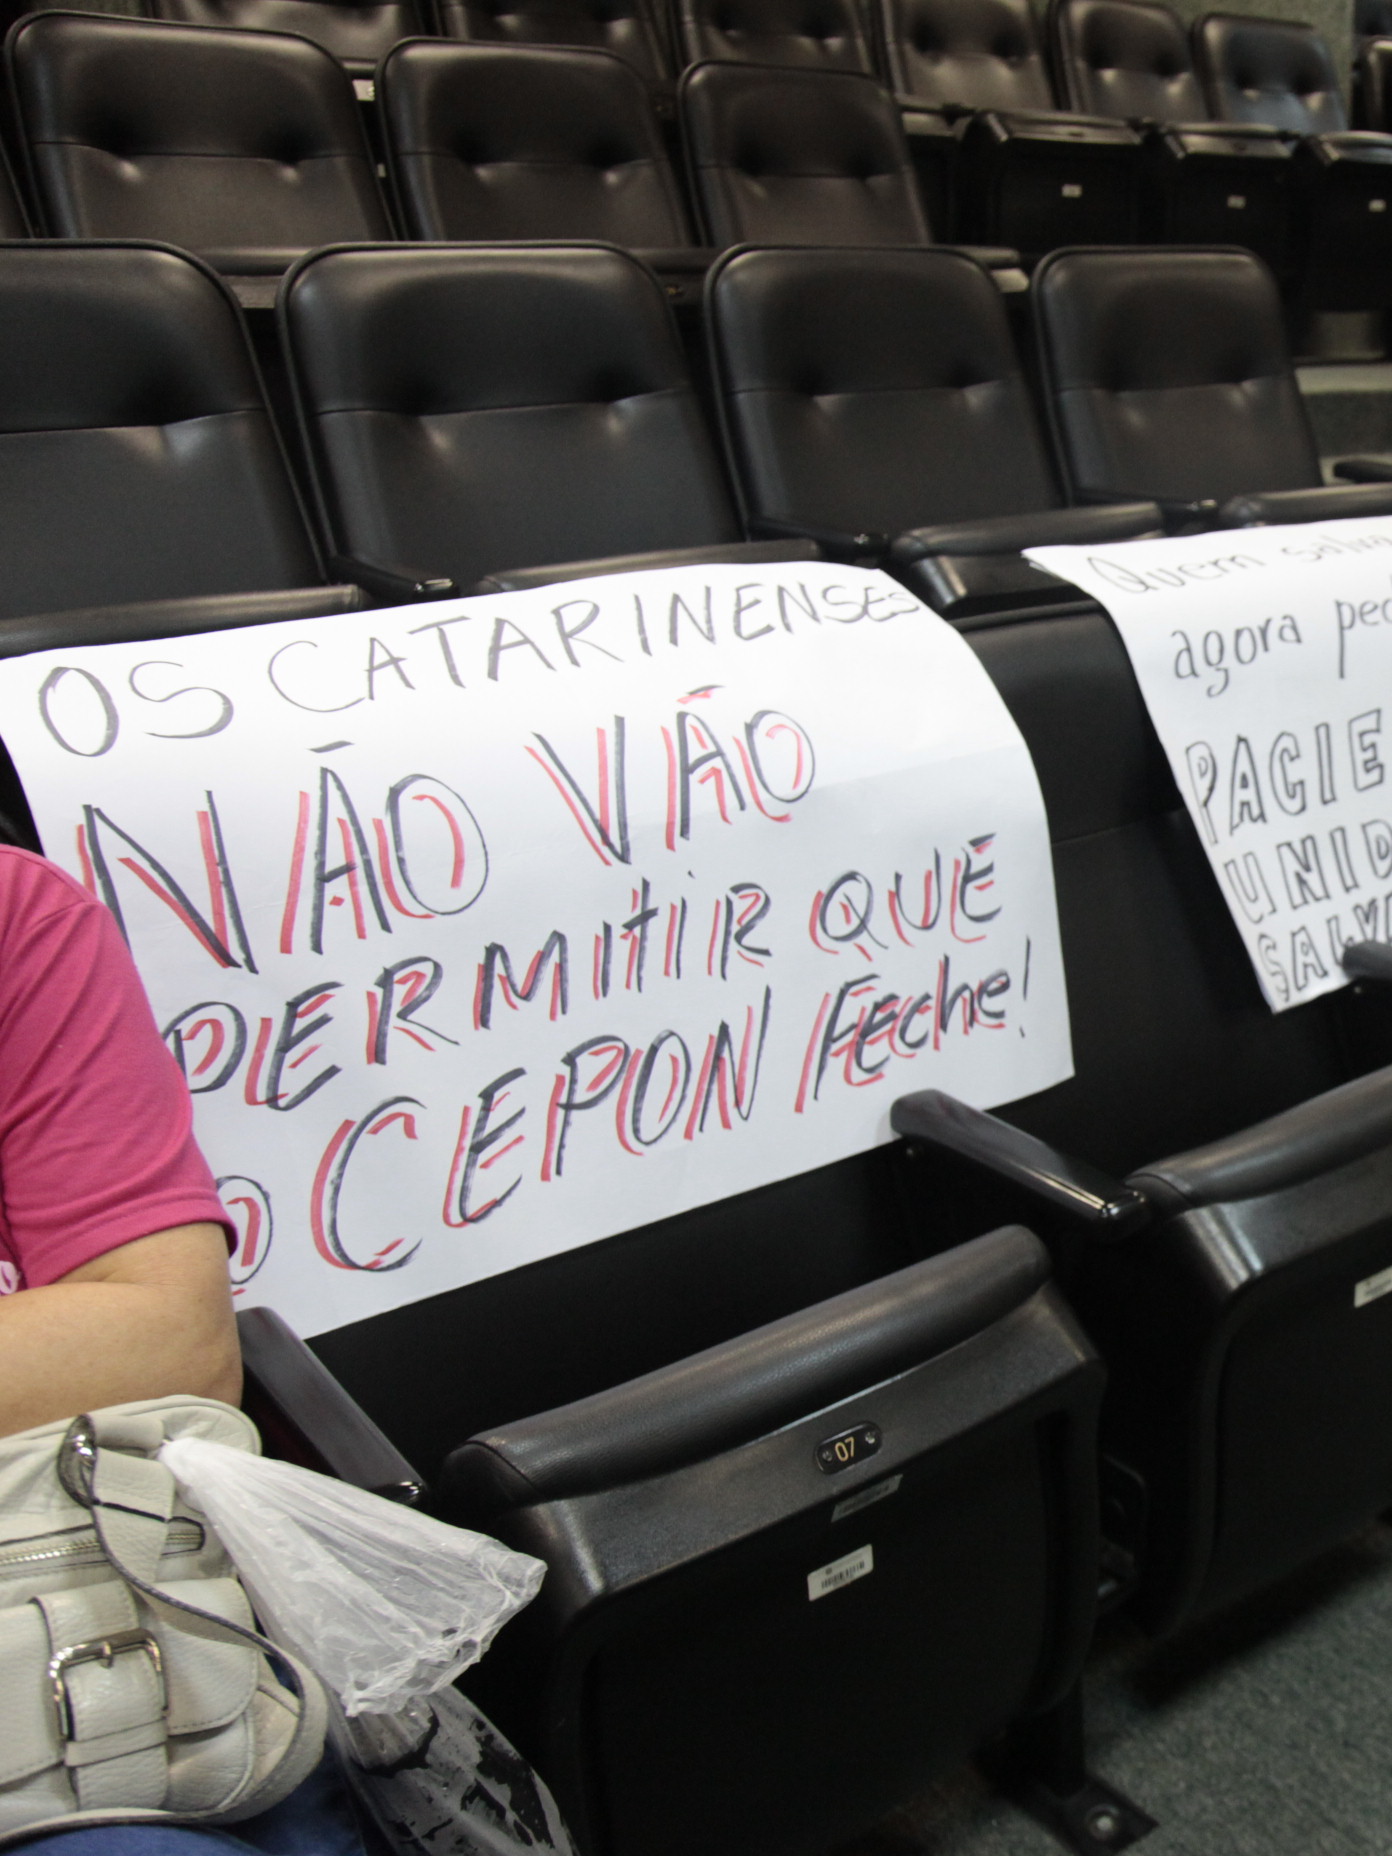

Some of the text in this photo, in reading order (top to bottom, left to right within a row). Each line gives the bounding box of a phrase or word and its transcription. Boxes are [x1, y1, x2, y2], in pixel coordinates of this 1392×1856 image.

[1087, 553, 1266, 595] Quem
[38, 582, 920, 757] OS CATARINENSES
[1171, 614, 1302, 698] agora
[77, 685, 815, 974] NÃO VÃO
[310, 984, 771, 1272] CEPON
[834, 1436, 856, 1462] 07
